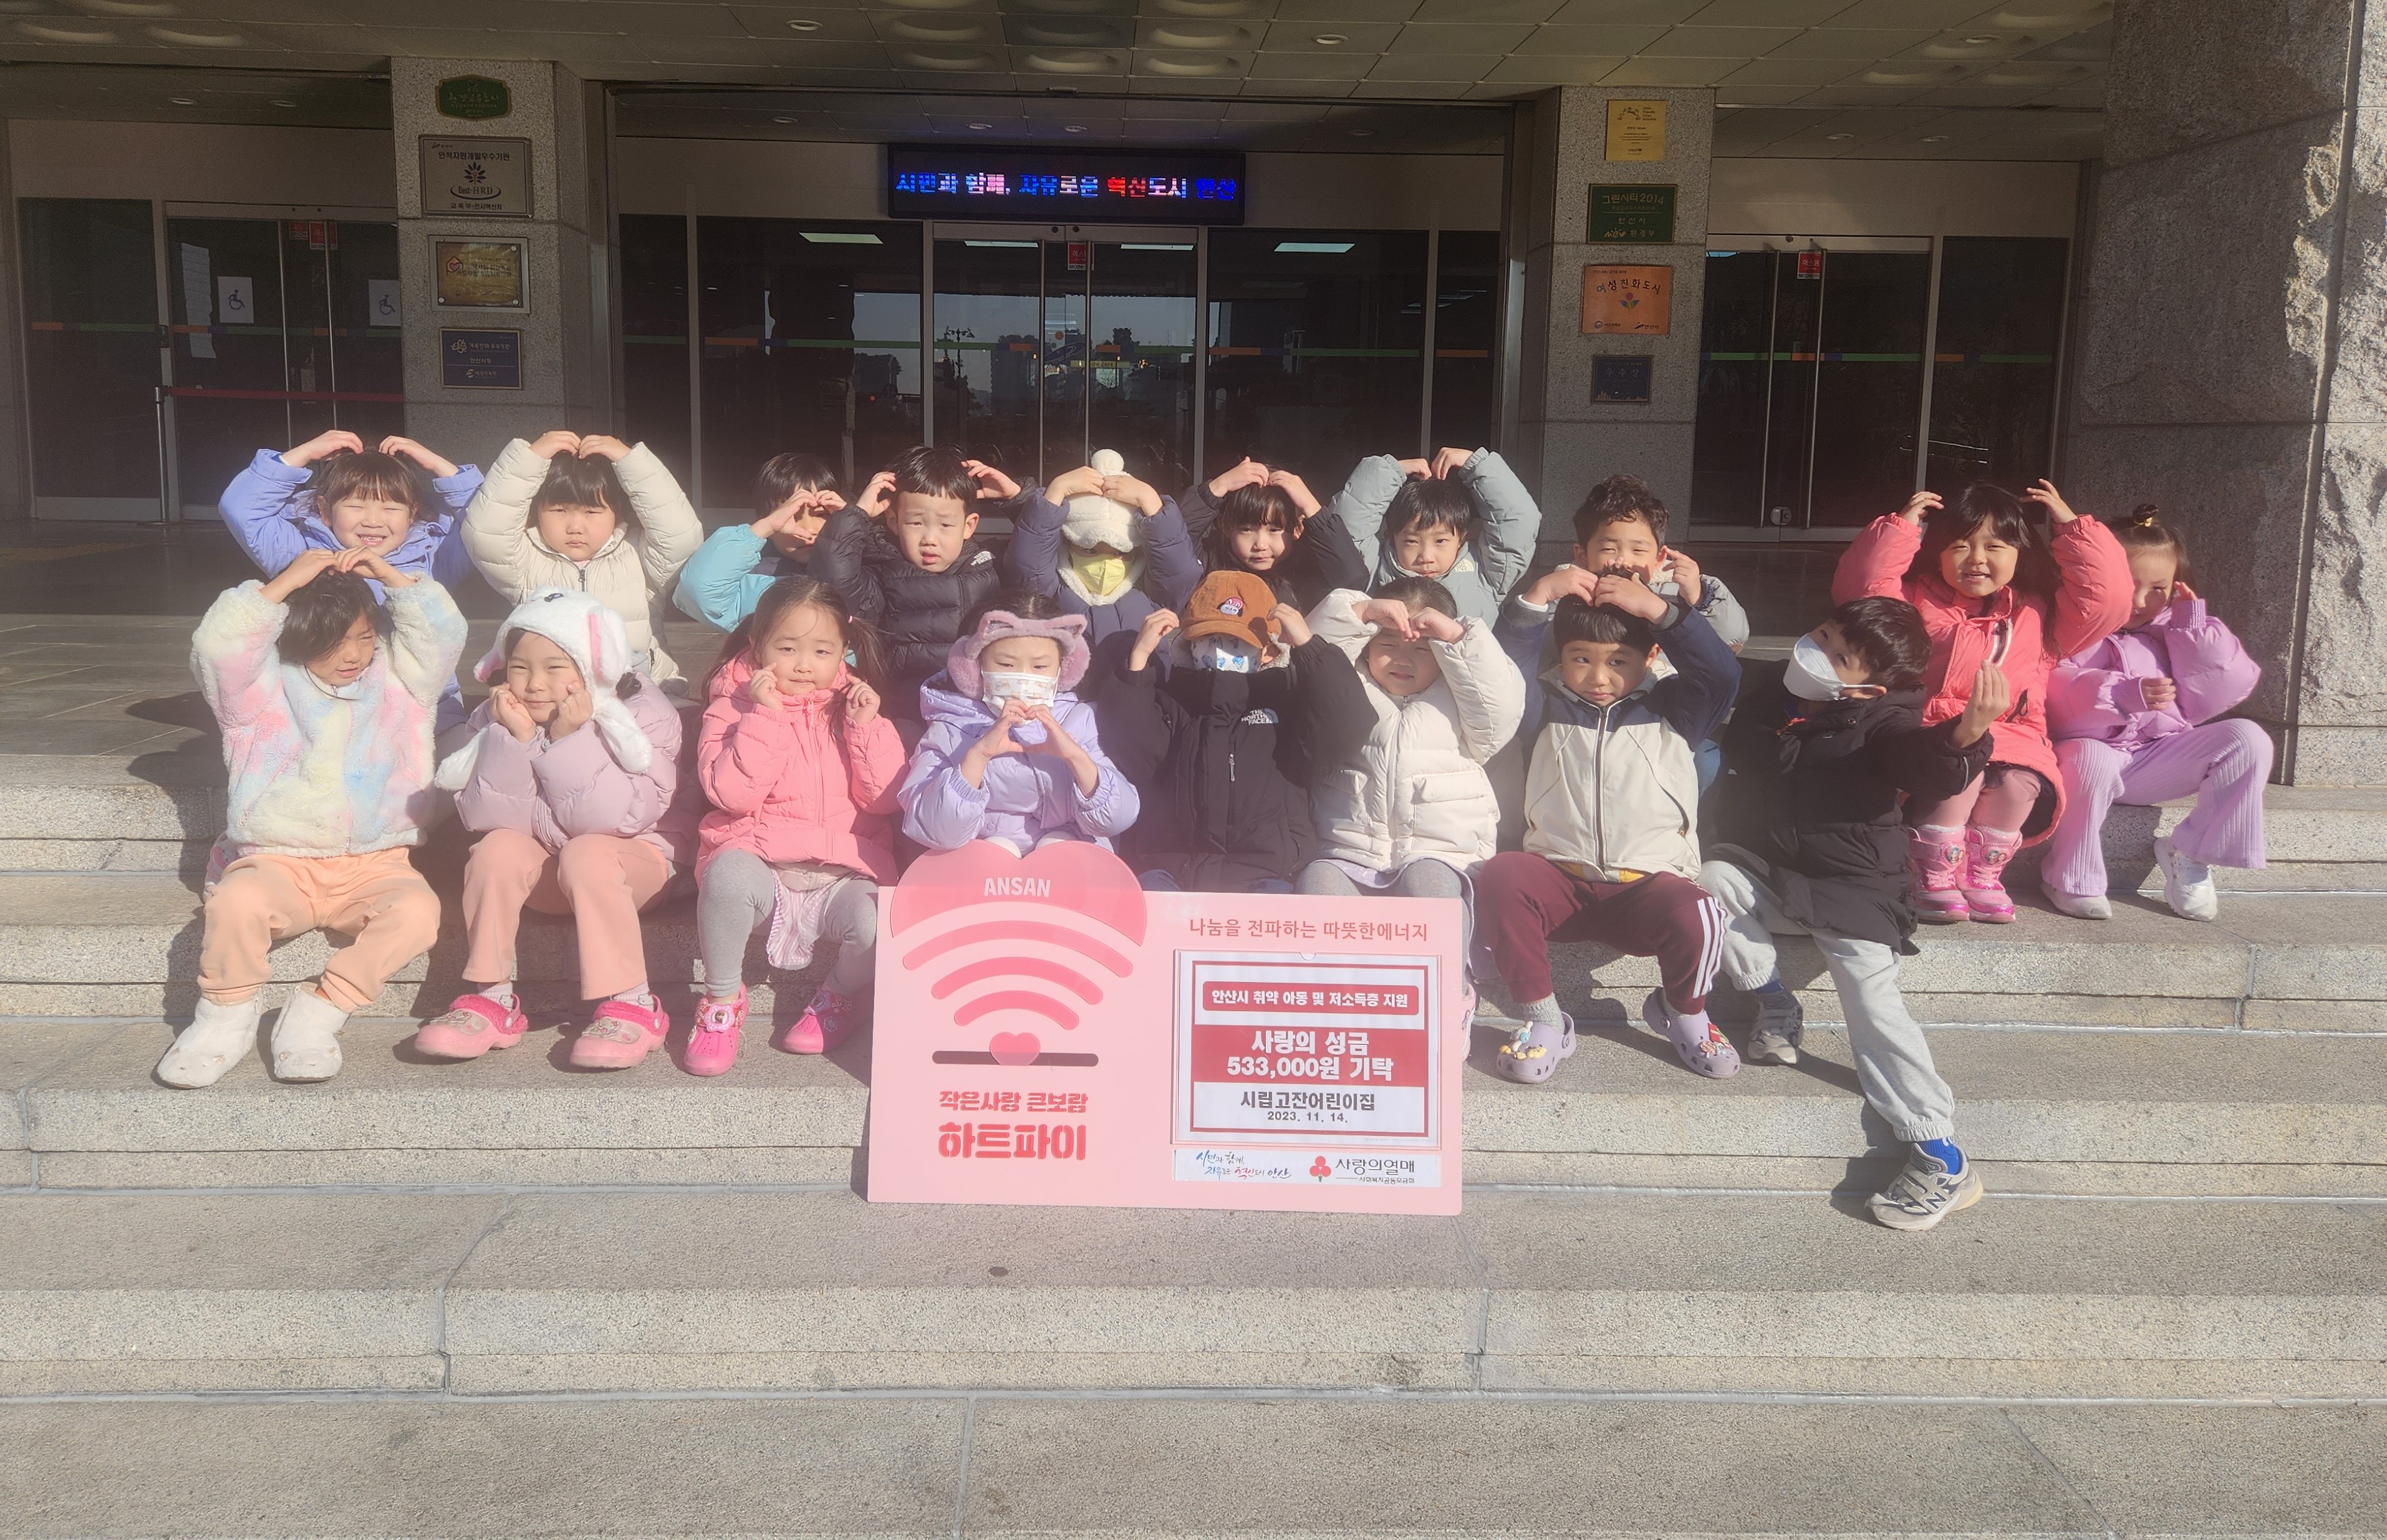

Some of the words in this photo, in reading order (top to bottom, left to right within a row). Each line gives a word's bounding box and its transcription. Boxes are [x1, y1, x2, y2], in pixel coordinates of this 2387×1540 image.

[438, 151, 510, 161] 인적자원개발우수기관
[458, 186, 493, 195] Best-HRD
[895, 173, 959, 194] 시민과
[1019, 175, 1098, 197] 자유로운
[1107, 176, 1187, 198] 혁신도시
[1596, 278, 1661, 295] 여성친화도시
[1241, 711, 1265, 722] NORTH
[1248, 718, 1266, 726] FACE
[984, 877, 1051, 898] ANSAN
[1190, 918, 1242, 937] 나눔을
[1248, 919, 1317, 938] 전파하는
[1212, 989, 1248, 1004] 안산시
[1253, 990, 1279, 1004] 취약
[1283, 991, 1308, 1005] 아동
[1312, 991, 1324, 1006] 및
[1383, 993, 1408, 1008] 지원
[1251, 1030, 1316, 1054] 사랑의
[1325, 1031, 1369, 1056] 성금
[1227, 1056, 1340, 1080] 533,000원
[1349, 1057, 1394, 1081] 기탁
[939, 1091, 1021, 1112] 작은사랑
[1026, 1092, 1088, 1113] 큰보람
[1240, 1090, 1375, 1111] 시립고잔어린이집
[1267, 1111, 1300, 1122] 2023.
[1306, 1112, 1324, 1122] 11.
[1330, 1112, 1348, 1123] 14.
[938, 1122, 1086, 1160] 하트파이
[1196, 1150, 1224, 1167] 시민과
[1335, 1158, 1415, 1175] 사랑의열매
[1204, 1167, 1232, 1180] 자유로운
[1234, 1167, 1265, 1180] 혁신도시
[1268, 1167, 1292, 1179] 안산
[1924, 1191, 1947, 1211] N
